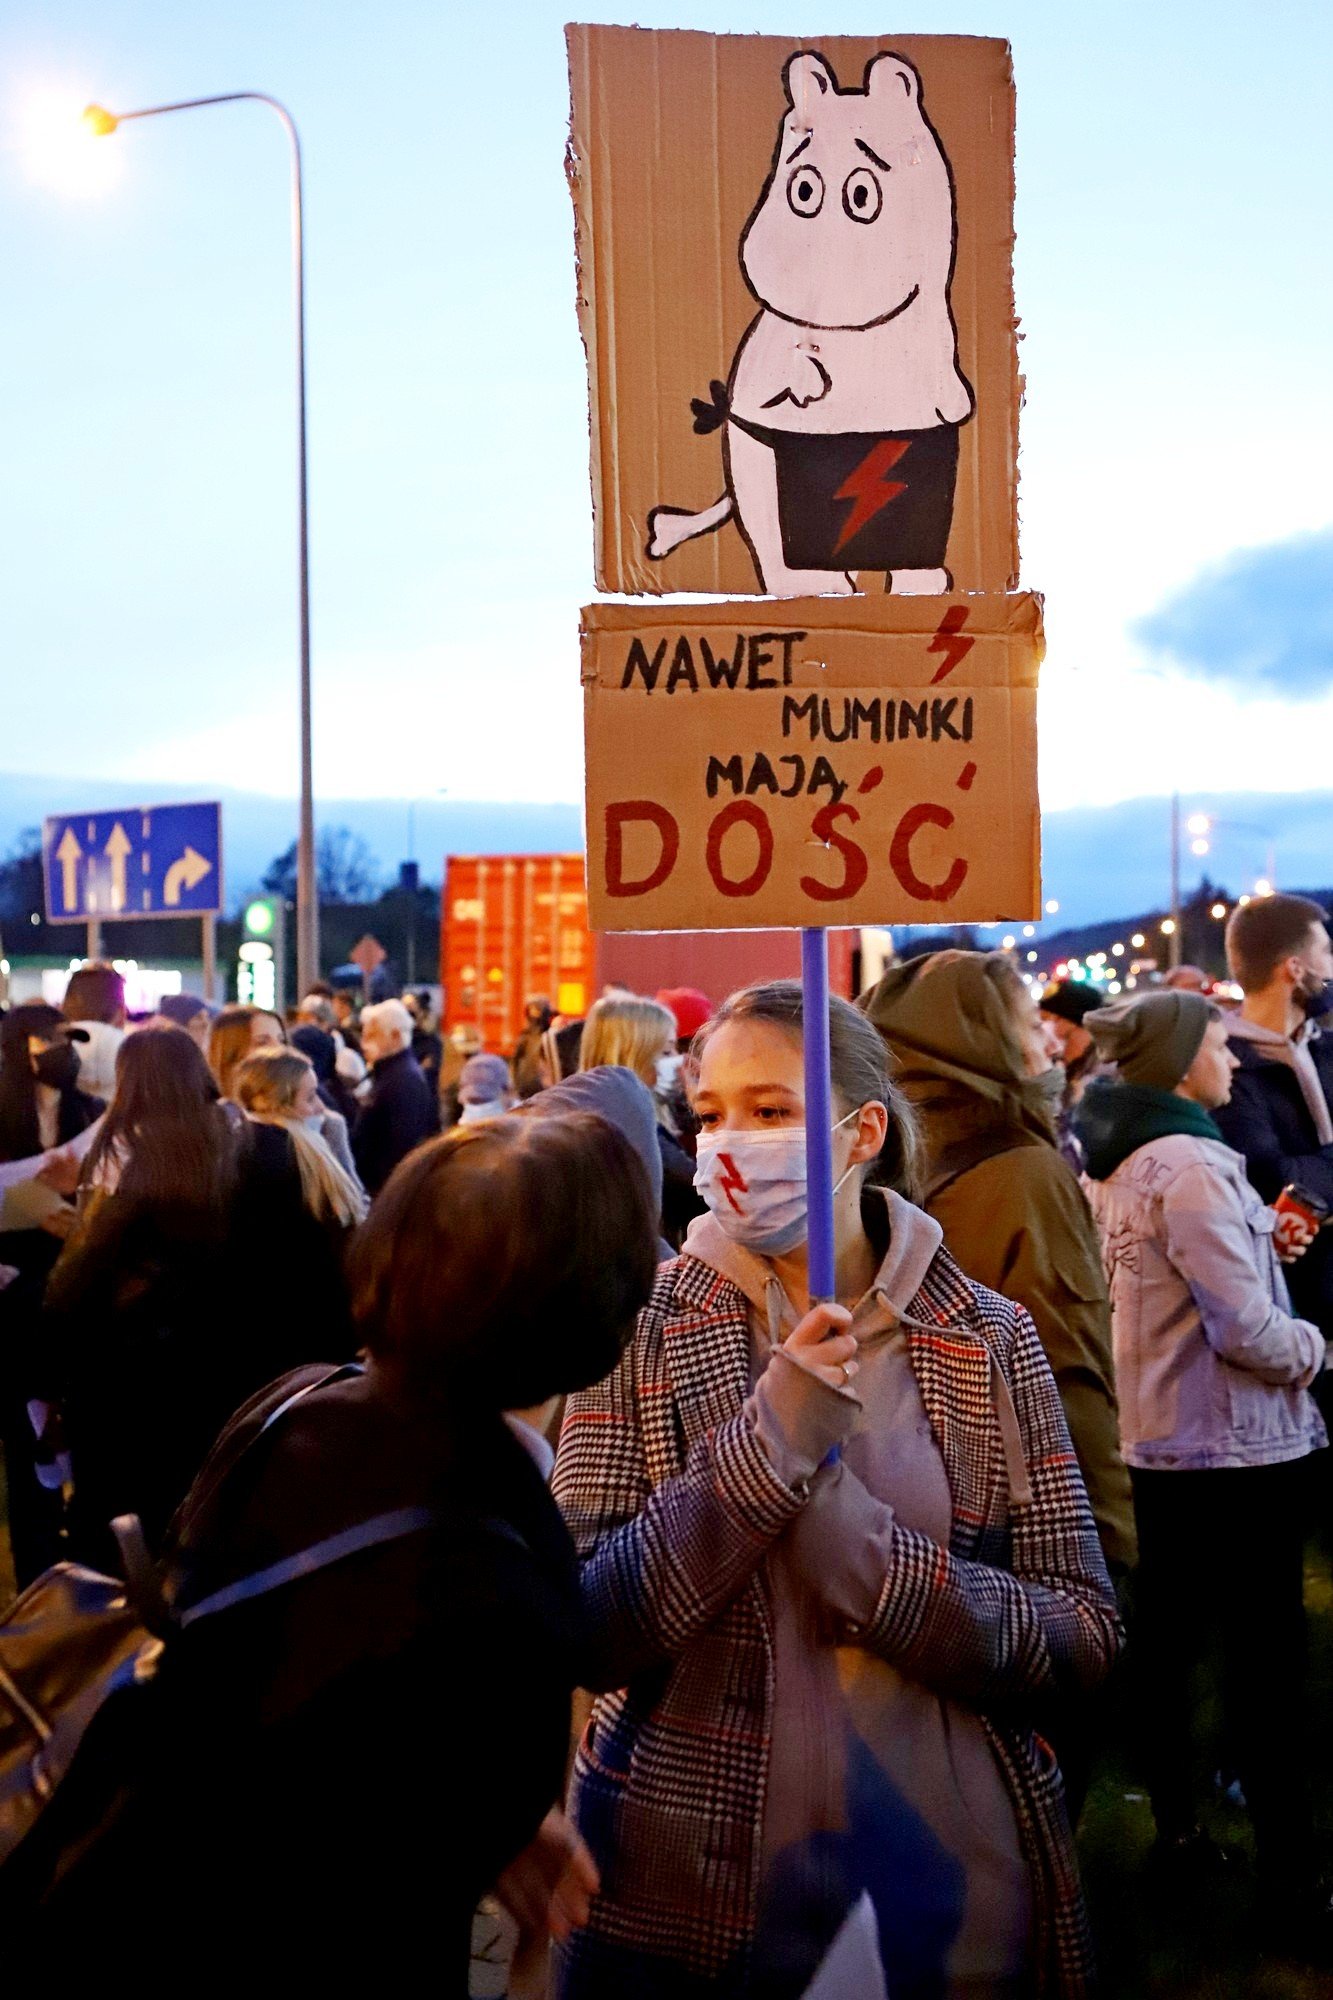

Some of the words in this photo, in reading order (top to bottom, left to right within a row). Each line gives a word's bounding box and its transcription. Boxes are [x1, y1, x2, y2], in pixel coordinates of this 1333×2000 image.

[620, 632, 807, 695] NAWET
[782, 694, 973, 743] MUMINKI
[706, 752, 848, 804] MAJĄ
[604, 761, 977, 903] DOŚĆ
